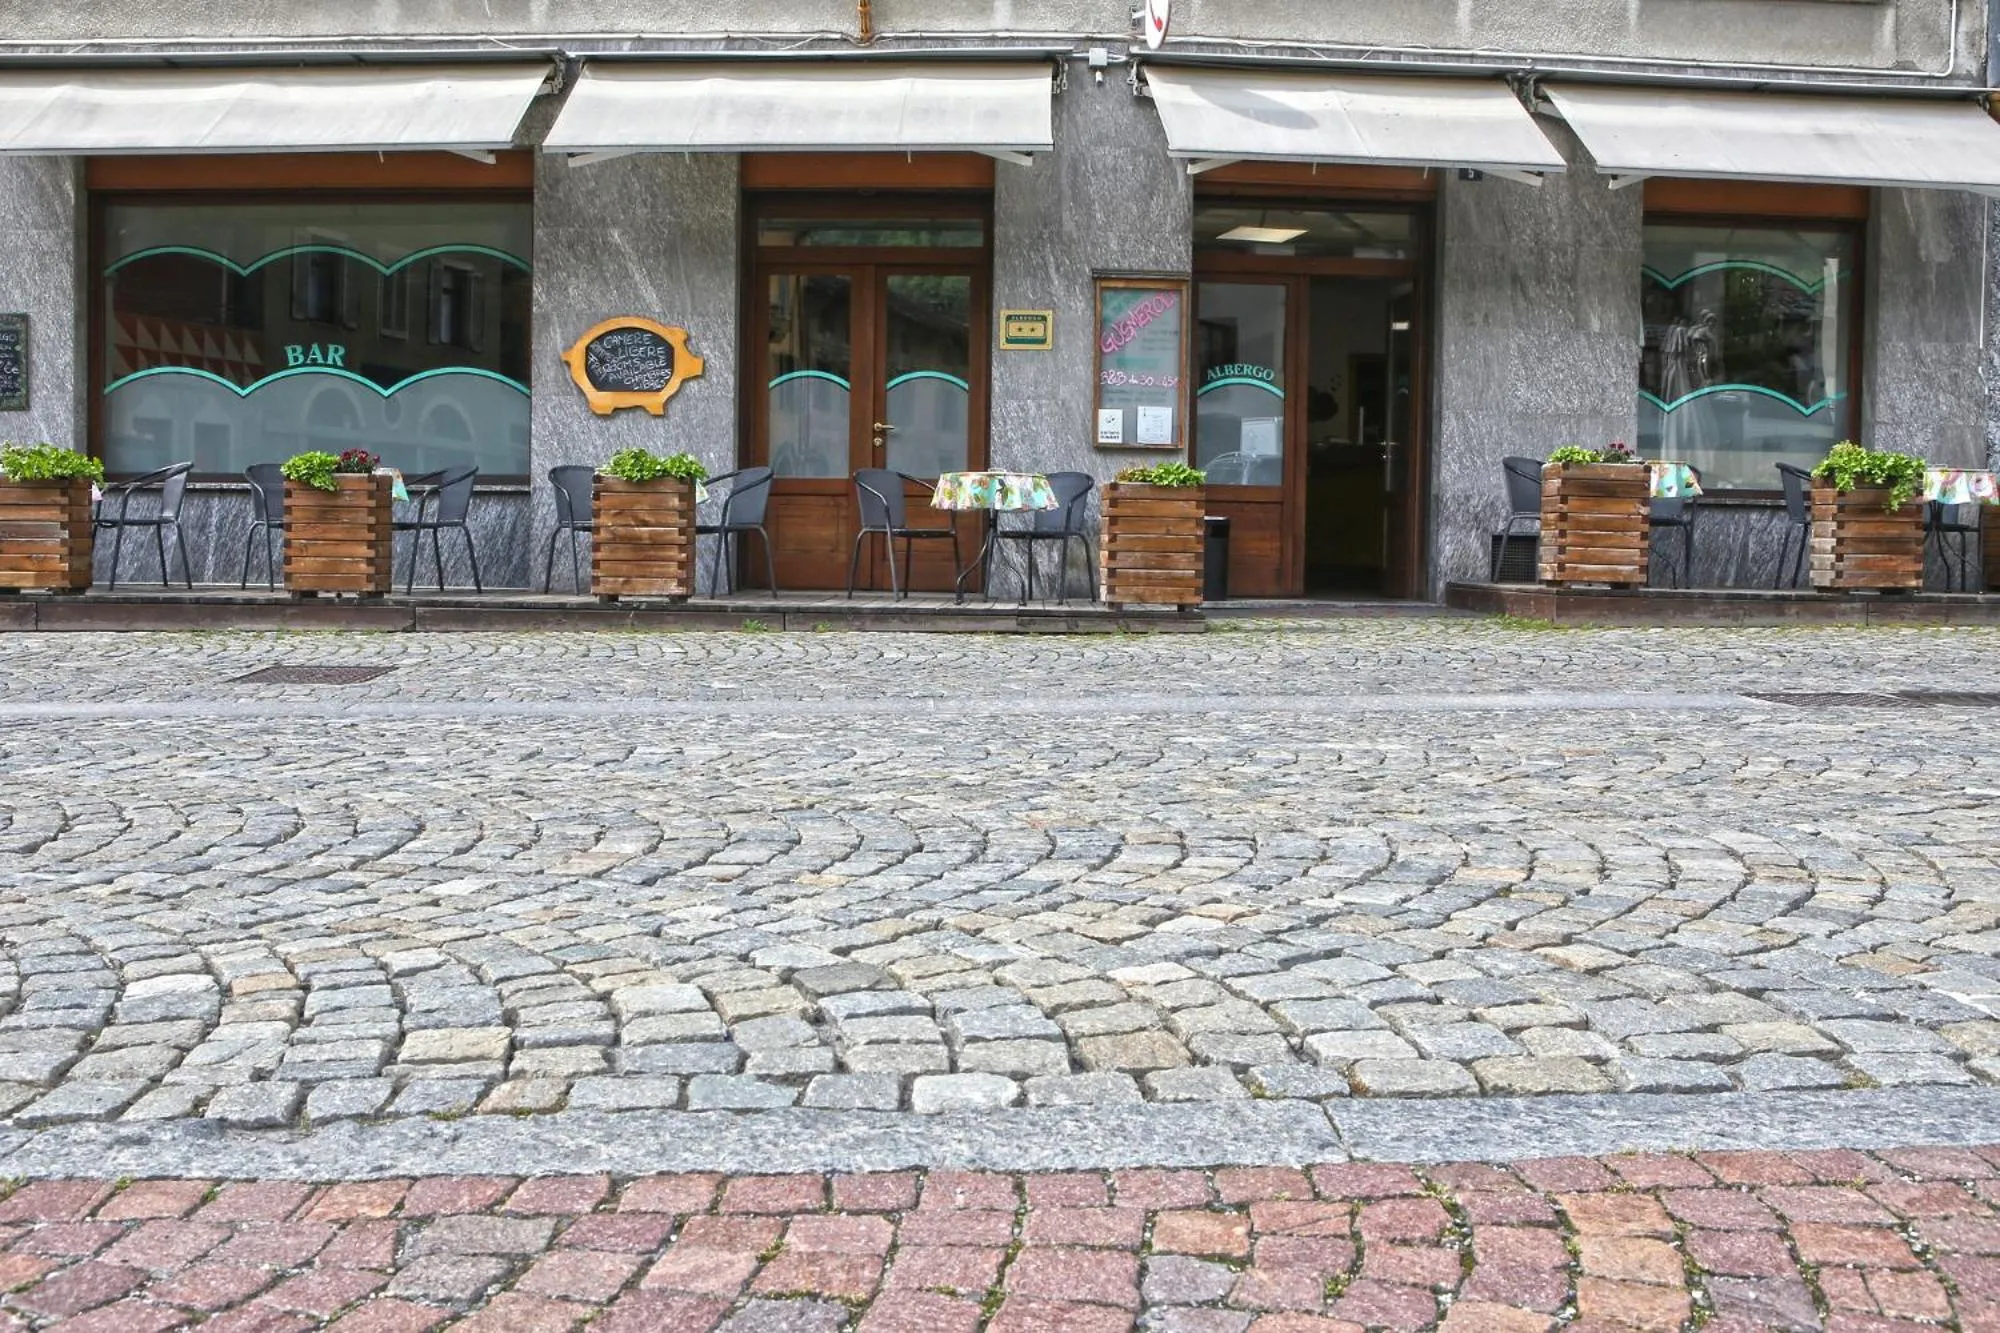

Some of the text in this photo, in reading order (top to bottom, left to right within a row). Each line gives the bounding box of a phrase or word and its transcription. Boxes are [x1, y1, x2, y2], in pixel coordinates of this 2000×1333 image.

[603, 331, 653, 349] CAMERE
[284, 342, 346, 367] BAR
[1207, 363, 1275, 381] ALBERGO
